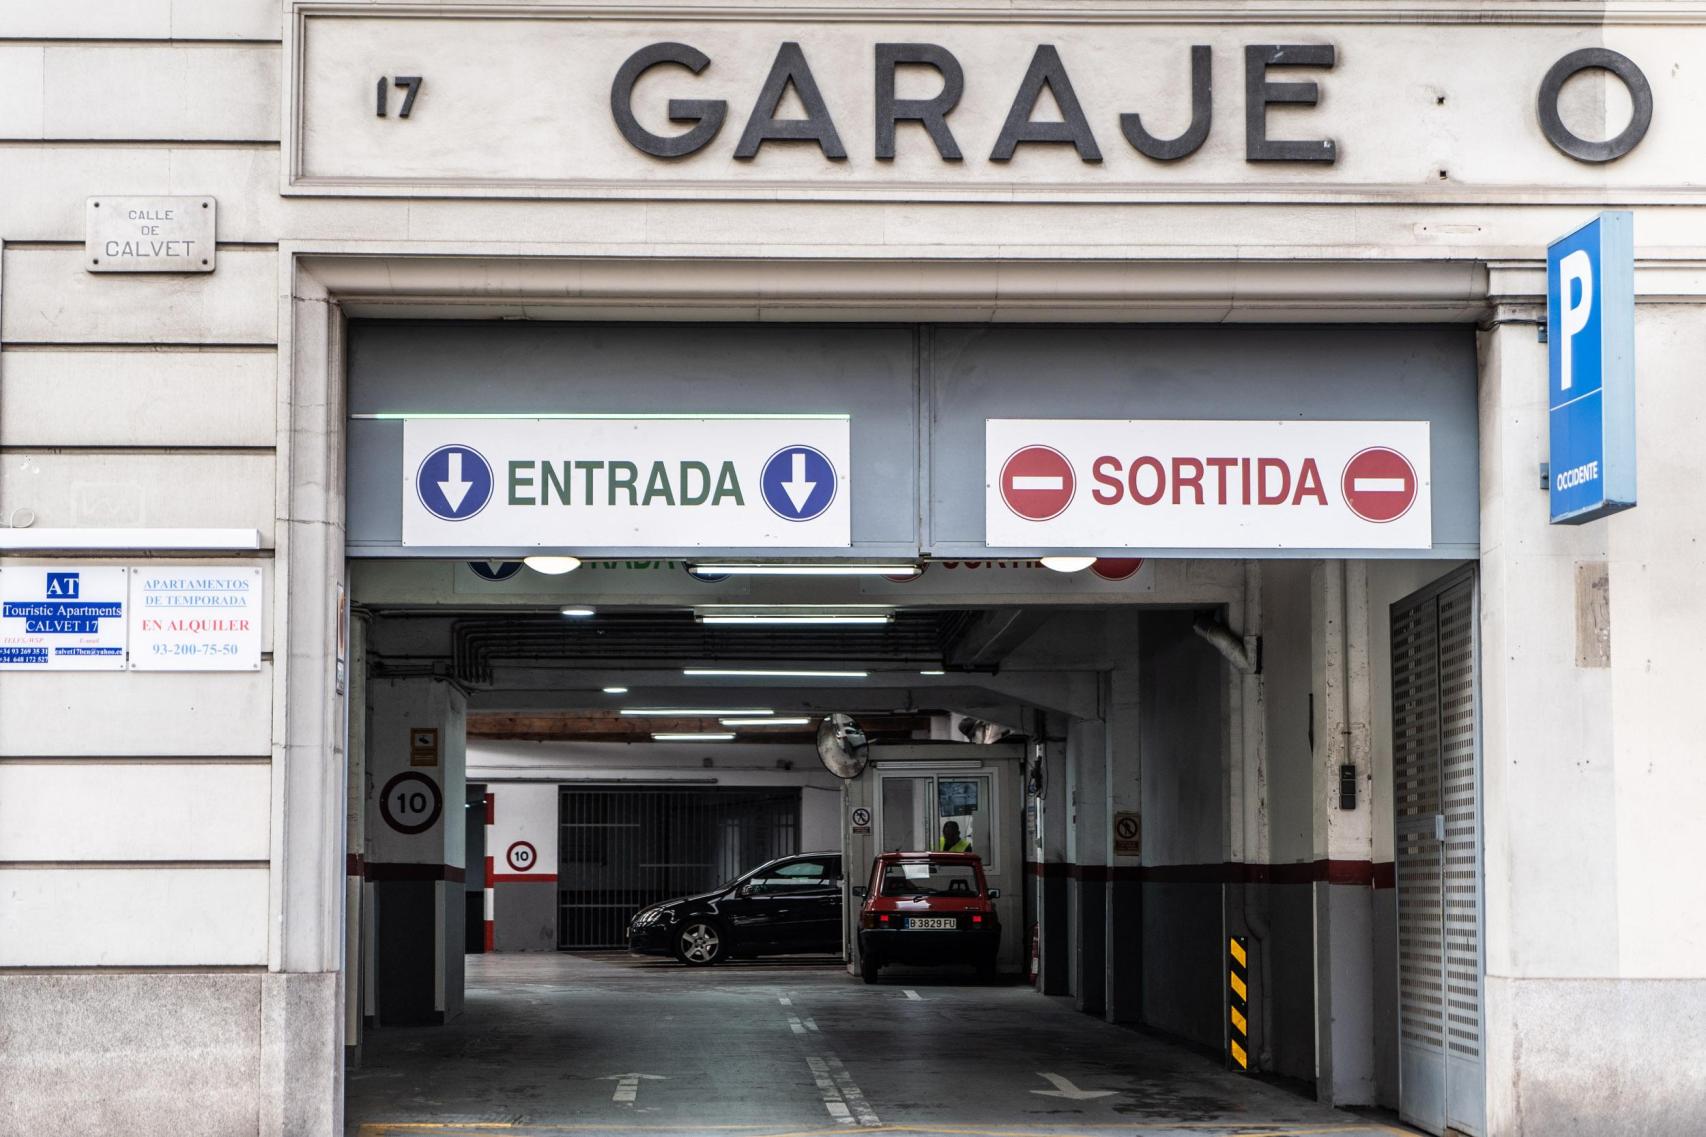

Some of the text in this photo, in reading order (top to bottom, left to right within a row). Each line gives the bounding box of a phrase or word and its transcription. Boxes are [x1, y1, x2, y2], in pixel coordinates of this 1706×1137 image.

[376, 75, 423, 119] 17
[610, 41, 1653, 165] GARAJE O
[128, 210, 174, 221] CALLE
[141, 225, 160, 236] DE
[105, 240, 196, 257] CALVET
[1559, 249, 1593, 392] P
[507, 460, 746, 506] ENTRADA
[1091, 455, 1329, 506] SORTIDA
[1556, 460, 1599, 491] OCCIDENTE
[46, 578, 80, 596] AT
[143, 579, 250, 589] APARTAMENTOS
[145, 595, 248, 605] DE TEMPORADA
[3, 604, 122, 618] Touristic Apartments
[25, 620, 99, 632] CALVET 17
[142, 619, 251, 633] EN ALQUILER
[152, 643, 239, 656] 93-200-75-50
[397, 792, 427, 814] 10
[514, 850, 529, 862] 10
